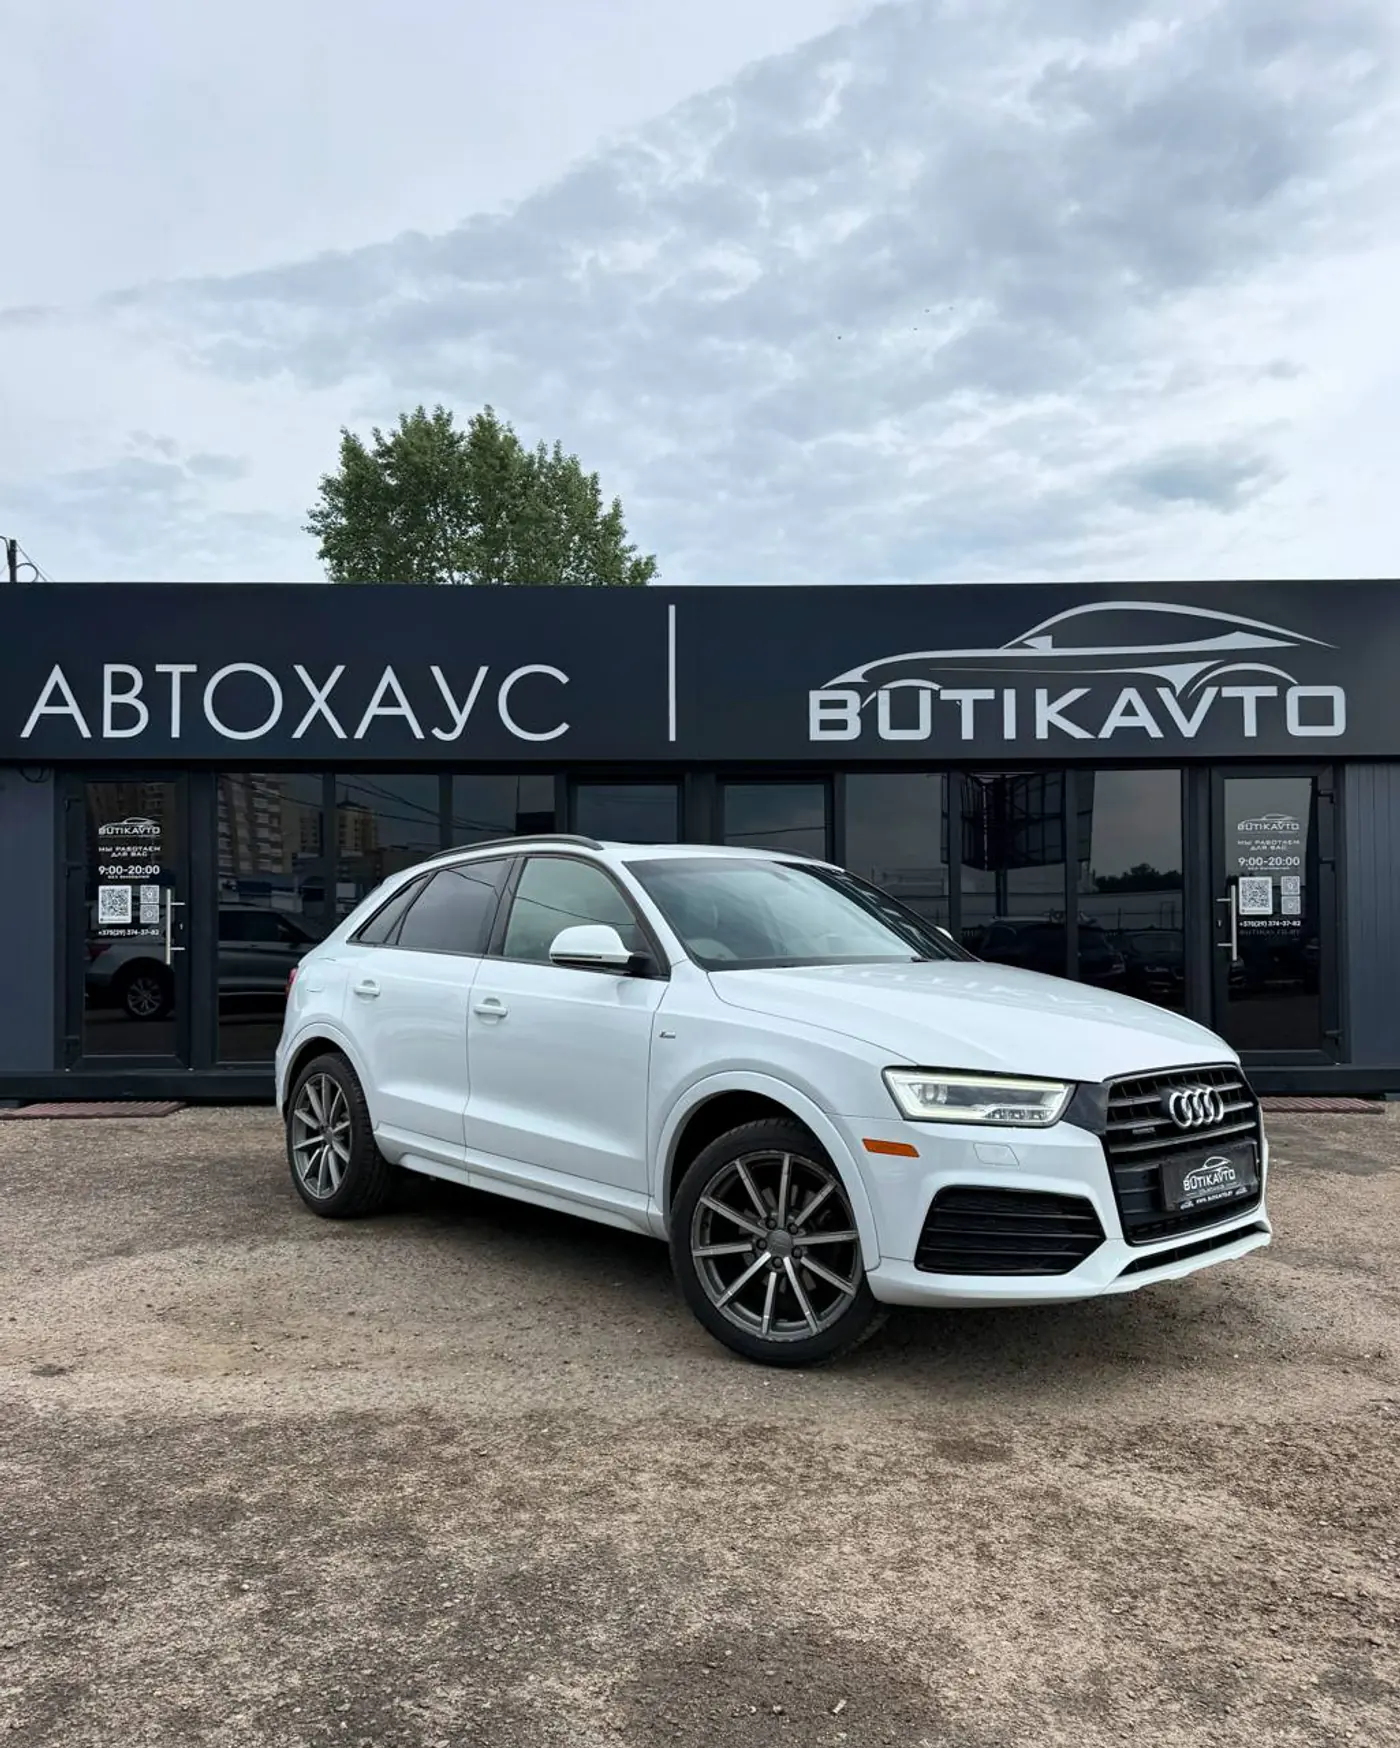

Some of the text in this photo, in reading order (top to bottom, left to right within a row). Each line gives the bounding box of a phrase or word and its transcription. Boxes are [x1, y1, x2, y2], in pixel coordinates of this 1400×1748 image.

[20, 662, 570, 741] АВТОХАУС
[809, 685, 1346, 741] BUTIKAVTO
[98, 826, 161, 835] BUTIKAVTO
[1237, 823, 1300, 831] BUTIKAVTO
[1238, 856, 1300, 867] 9:00-20:00
[98, 865, 160, 875] 9:00-20:00
[1183, 1169, 1236, 1191] BUTIKAVTO
